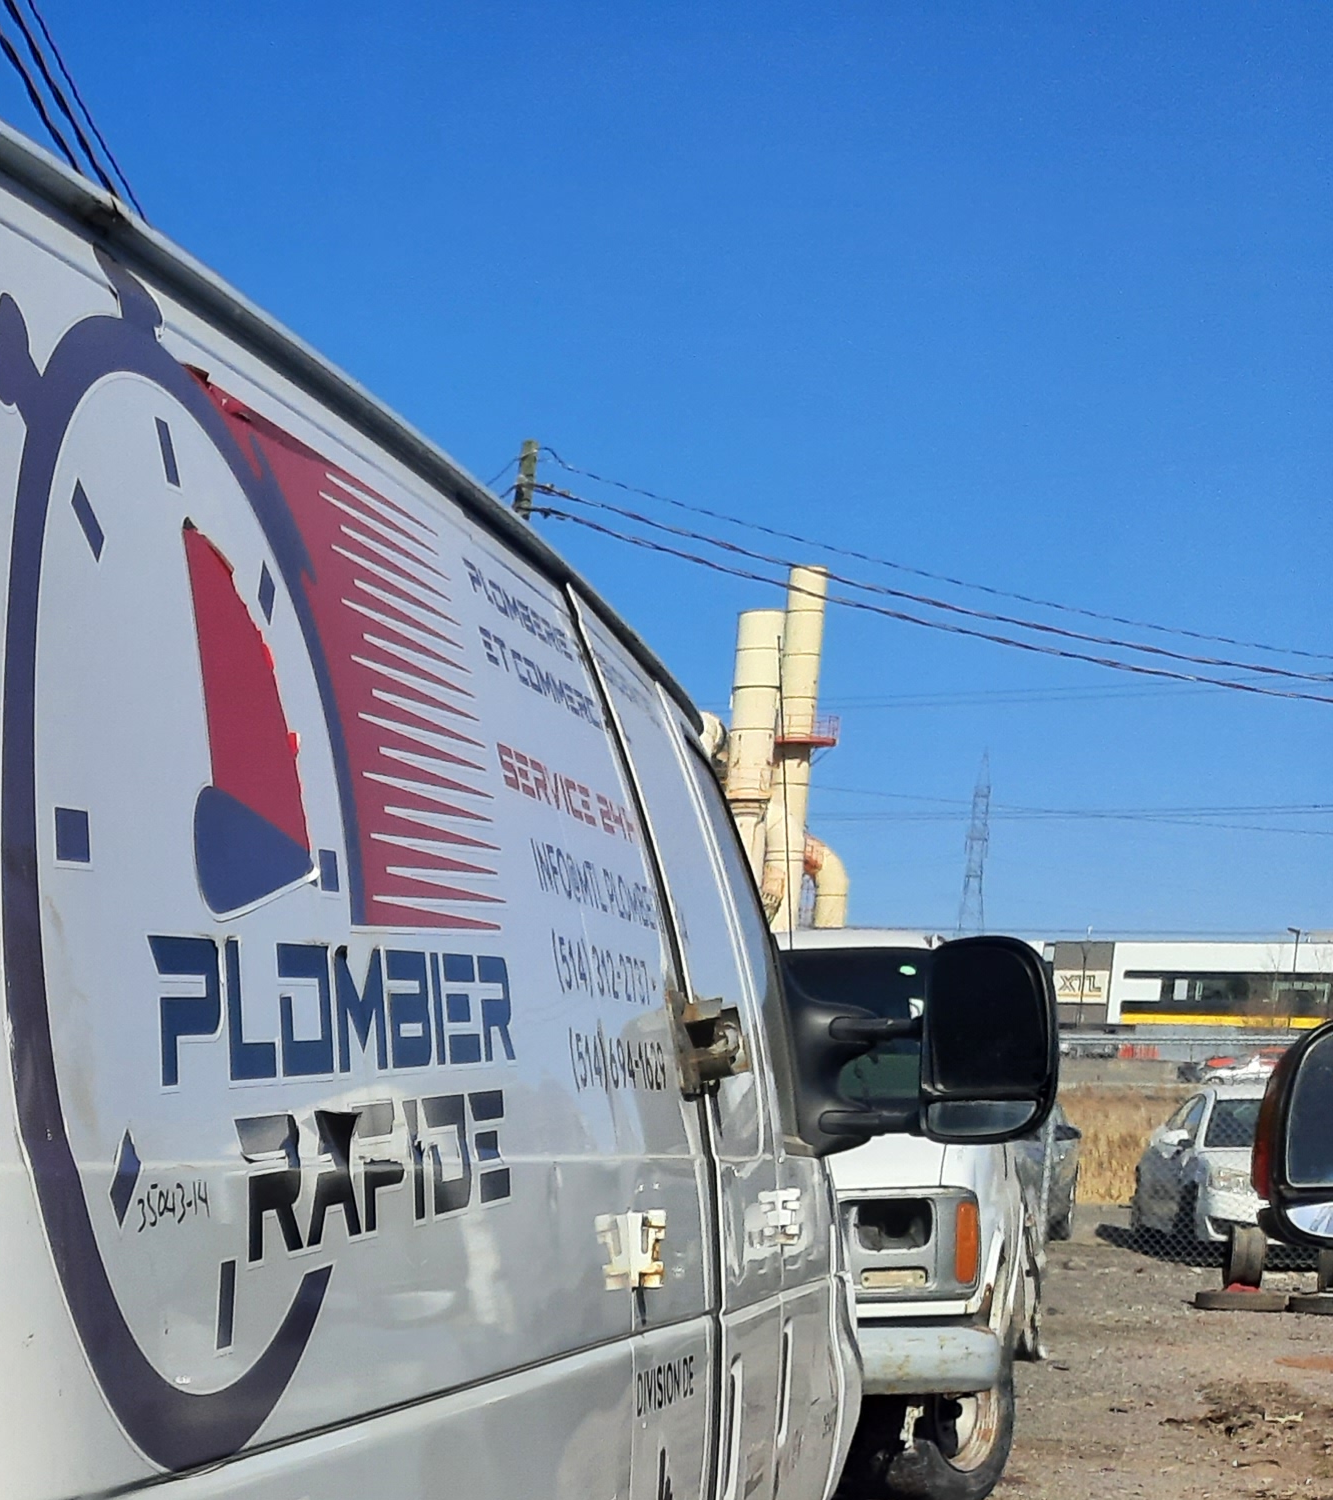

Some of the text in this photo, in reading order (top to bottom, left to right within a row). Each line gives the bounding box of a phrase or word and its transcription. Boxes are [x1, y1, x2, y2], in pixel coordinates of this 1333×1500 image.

[479, 626, 510, 673] ET
[497, 743, 597, 827] SERVICE
[552, 928, 650, 1005] (514) 312-2737
[1059, 974, 1102, 993] XTL
[147, 935, 515, 1086] PLOMBIER
[569, 1027, 666, 1094] (514) 694-1629
[137, 1180, 210, 1233] 35043-14
[234, 1090, 511, 1263] RAPIDE
[636, 1360, 681, 1417] DIVISION
